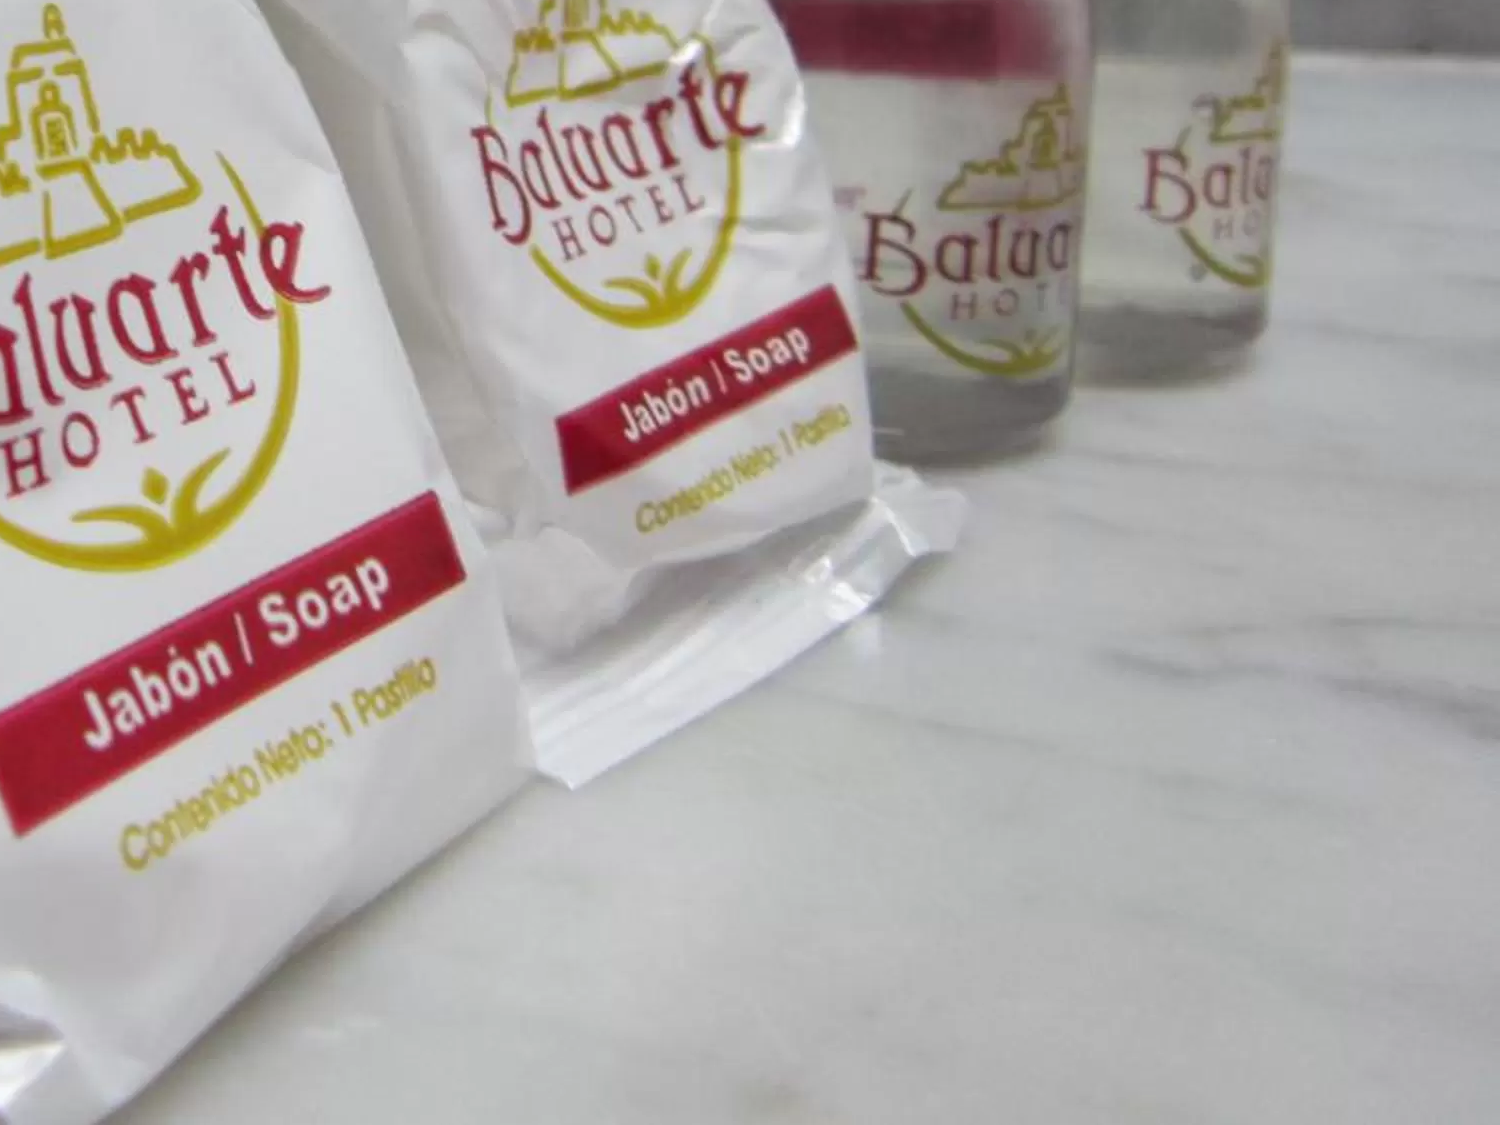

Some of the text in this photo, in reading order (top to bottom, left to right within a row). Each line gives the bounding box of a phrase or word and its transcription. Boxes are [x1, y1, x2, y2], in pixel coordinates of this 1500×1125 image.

[470, 62, 767, 246] Baluarte
[551, 174, 706, 261] HOTEL
[950, 281, 1070, 321] HOT
[619, 326, 810, 443] Jabón / Soap
[82, 556, 390, 752] Jabón / Soap
[119, 764, 262, 871] Contenido
[252, 718, 335, 784] Neto:
[330, 698, 355, 738] 1
